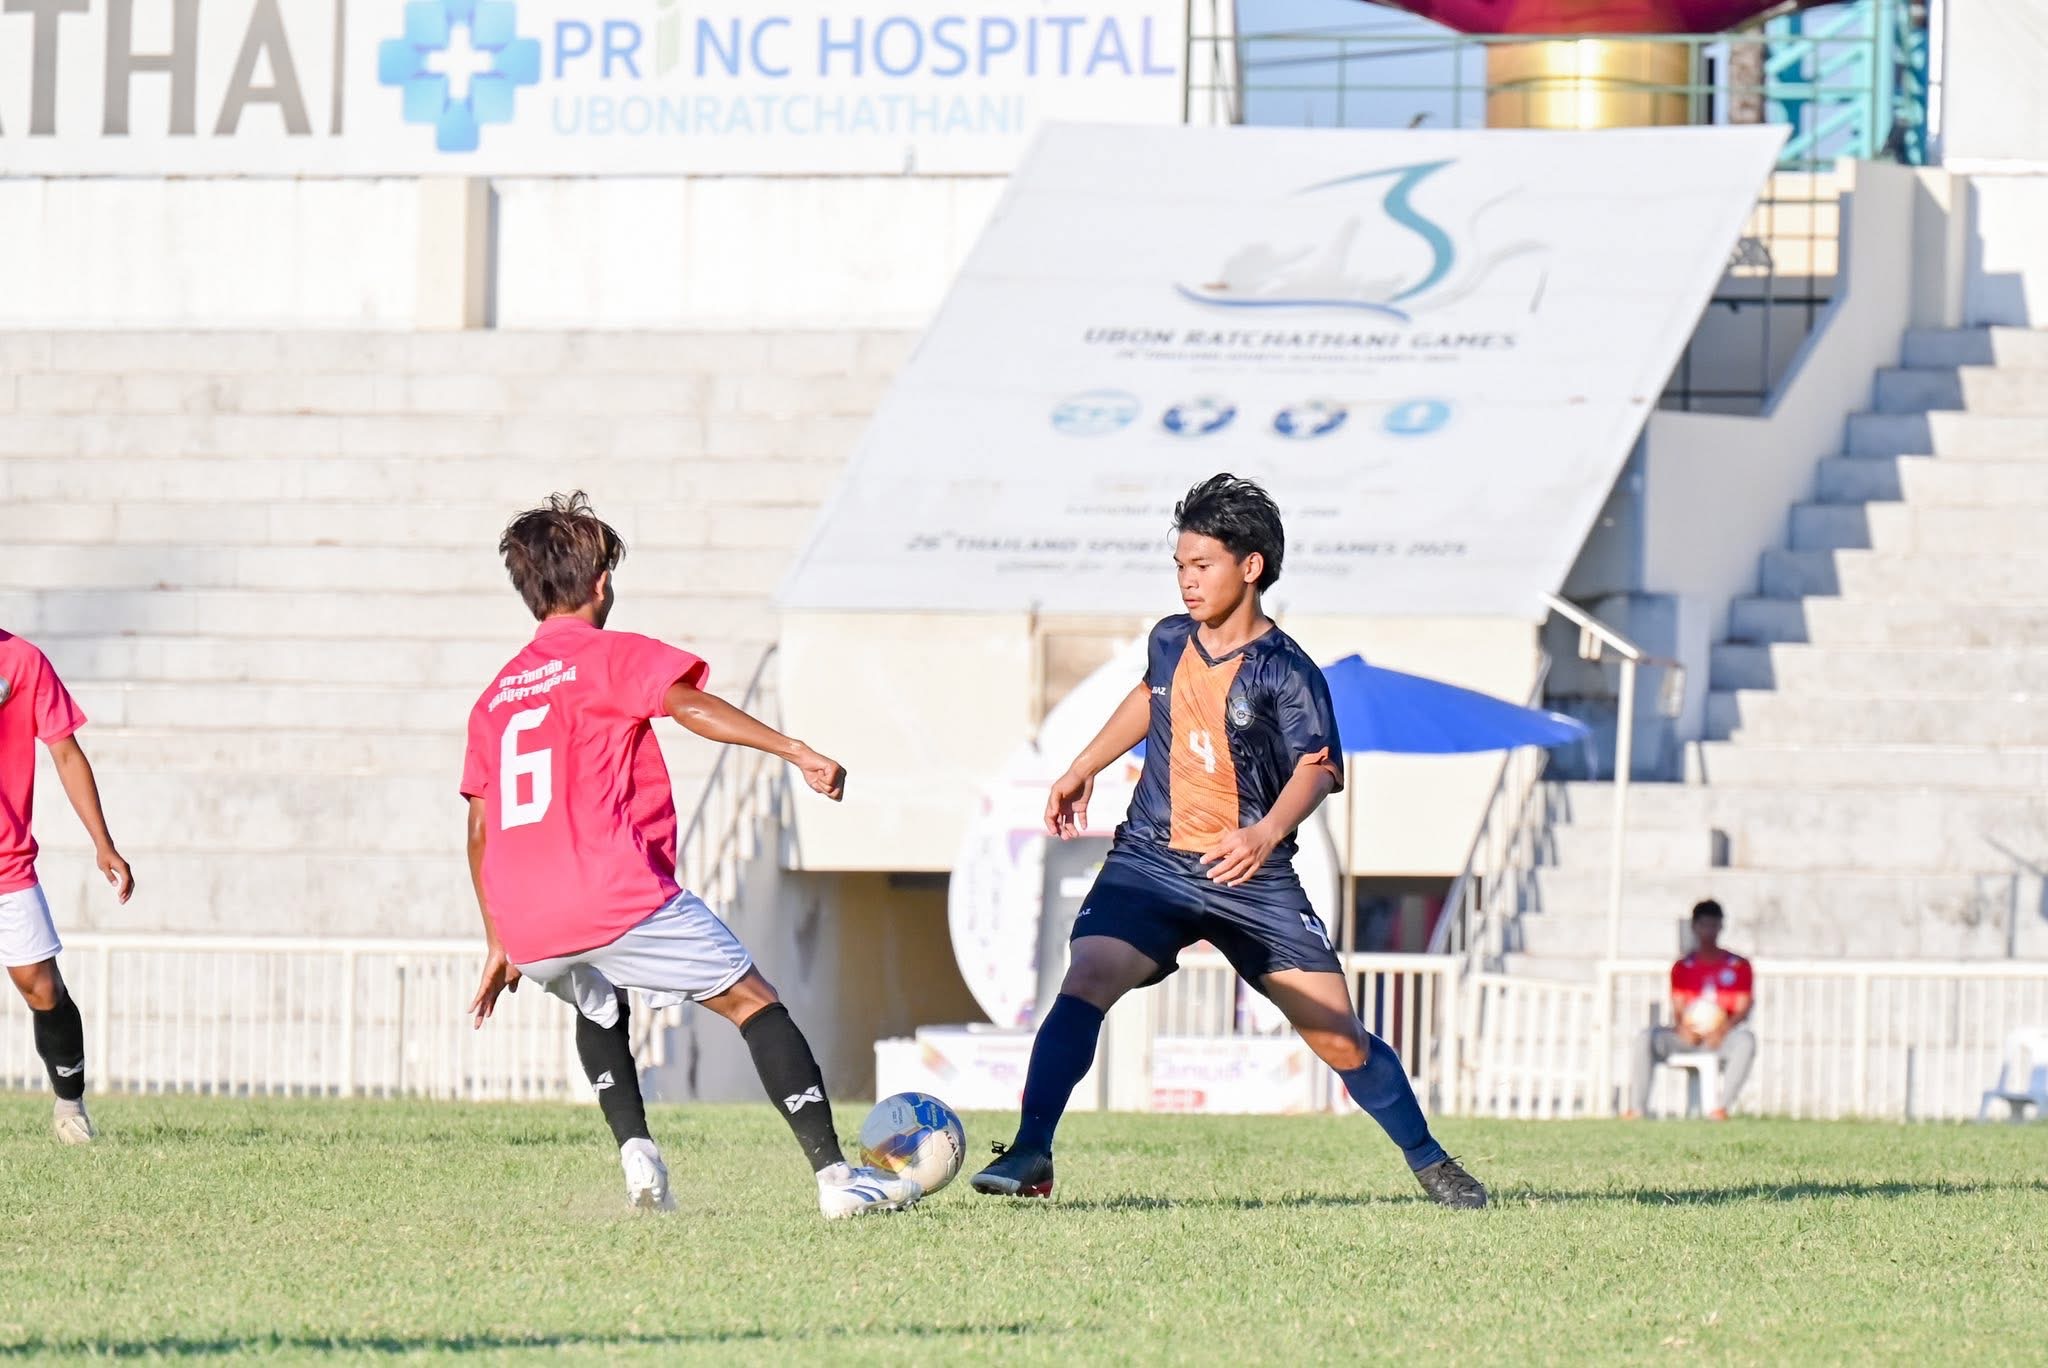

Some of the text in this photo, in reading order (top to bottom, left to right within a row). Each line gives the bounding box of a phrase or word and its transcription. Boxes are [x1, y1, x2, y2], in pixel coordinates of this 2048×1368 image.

[818, 15, 1177, 78] HOSPITAL
[552, 94, 1025, 136] UBONRATCHATHANI
[1084, 327, 1518, 350] UBON RATCHATHANI GAMES
[500, 703, 553, 831] 6
[1189, 730, 1217, 774] 4
